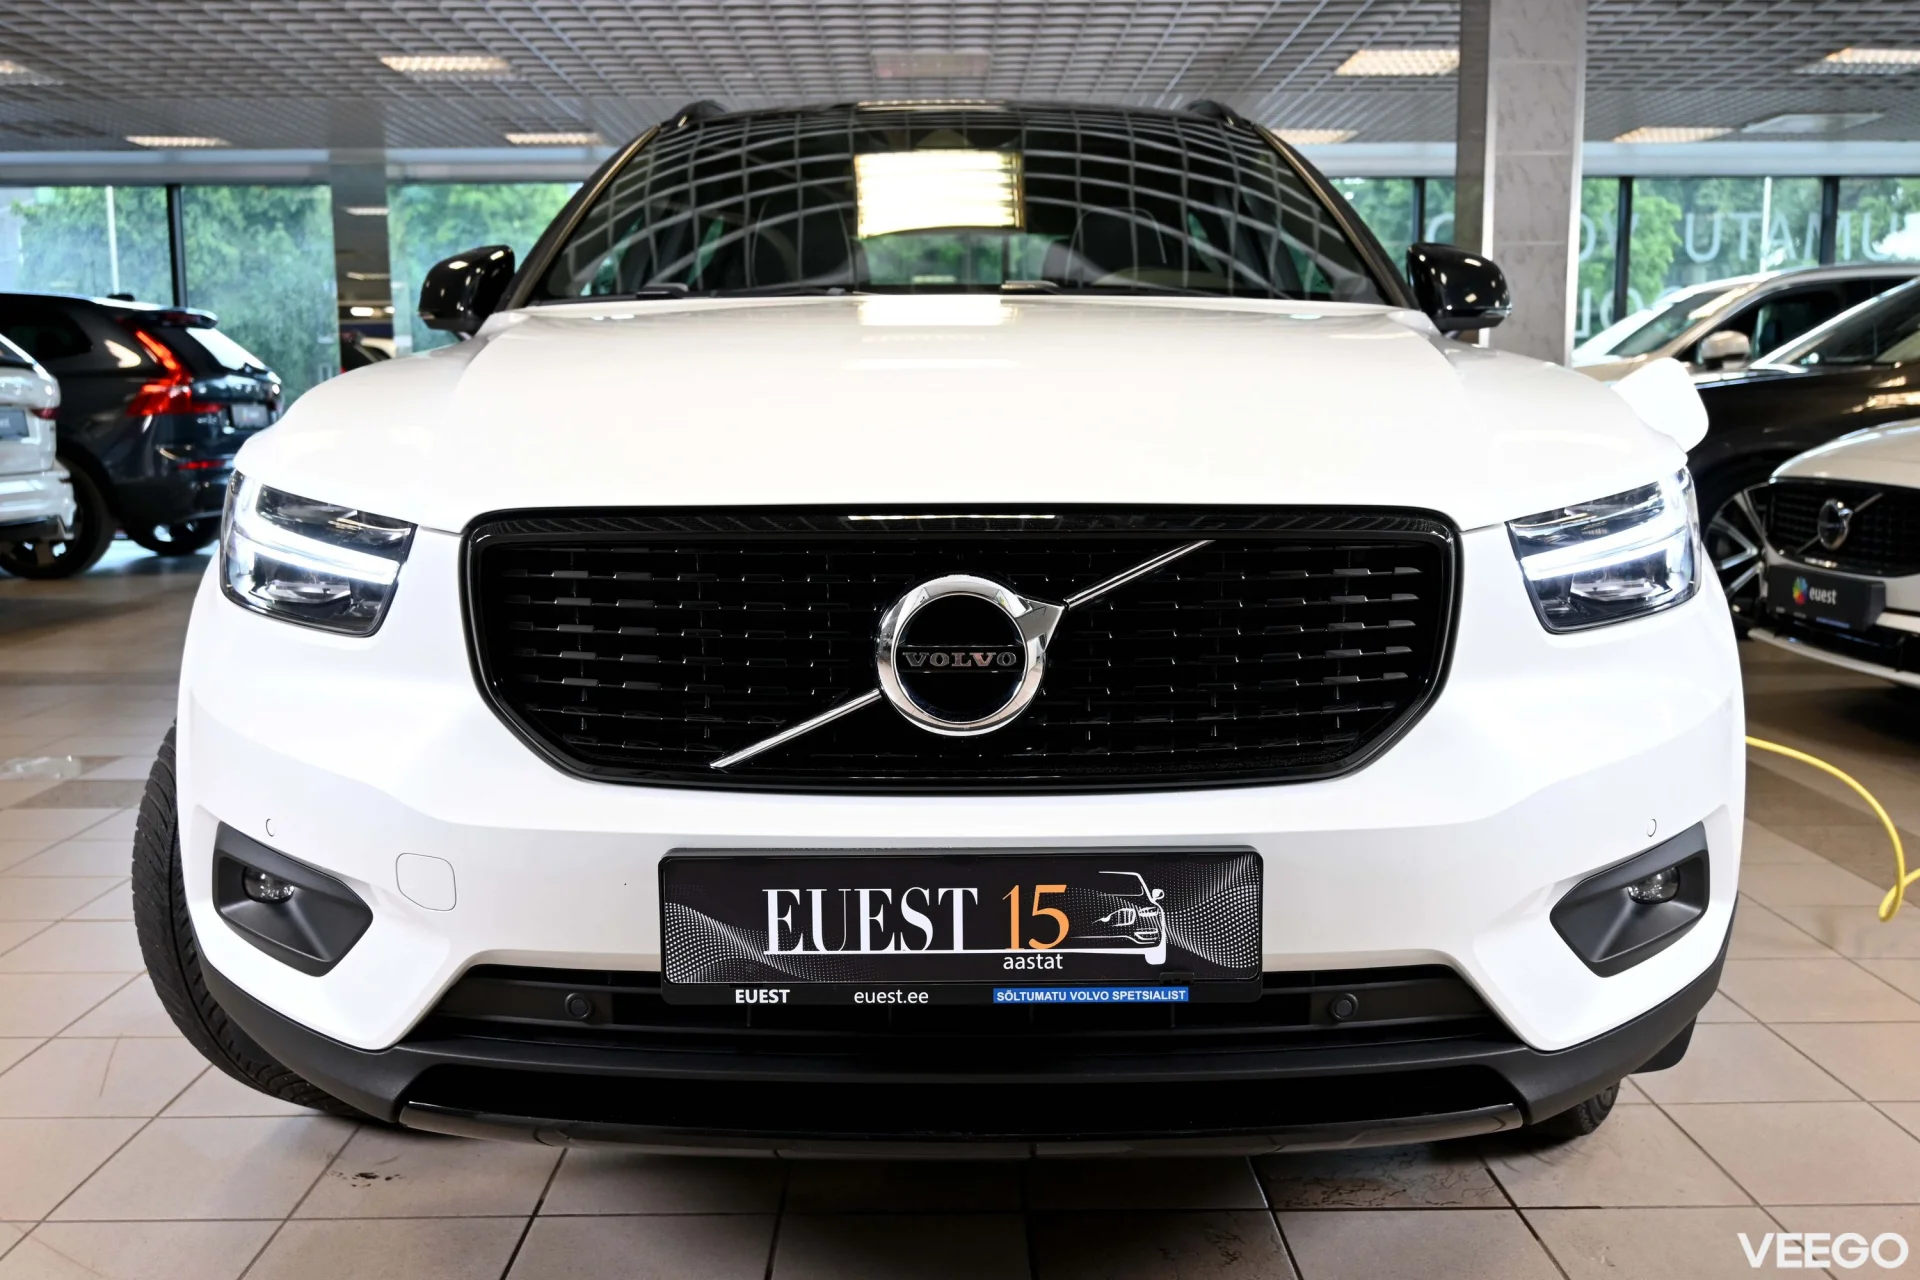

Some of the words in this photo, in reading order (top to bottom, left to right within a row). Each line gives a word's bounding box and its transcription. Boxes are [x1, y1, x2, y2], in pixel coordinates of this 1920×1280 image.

[902, 652, 1017, 667] VOLVO
[762, 887, 977, 952] EUEST
[1002, 884, 1069, 949] 15
[1003, 953, 1063, 970] aastat
[735, 989, 790, 1003] EUEST
[854, 989, 929, 1003] euest.ee
[996, 989, 1067, 1002] SÕLTUMATU
[1071, 990, 1110, 1001] VOLVO
[1112, 989, 1187, 1001] SPETSIALIST
